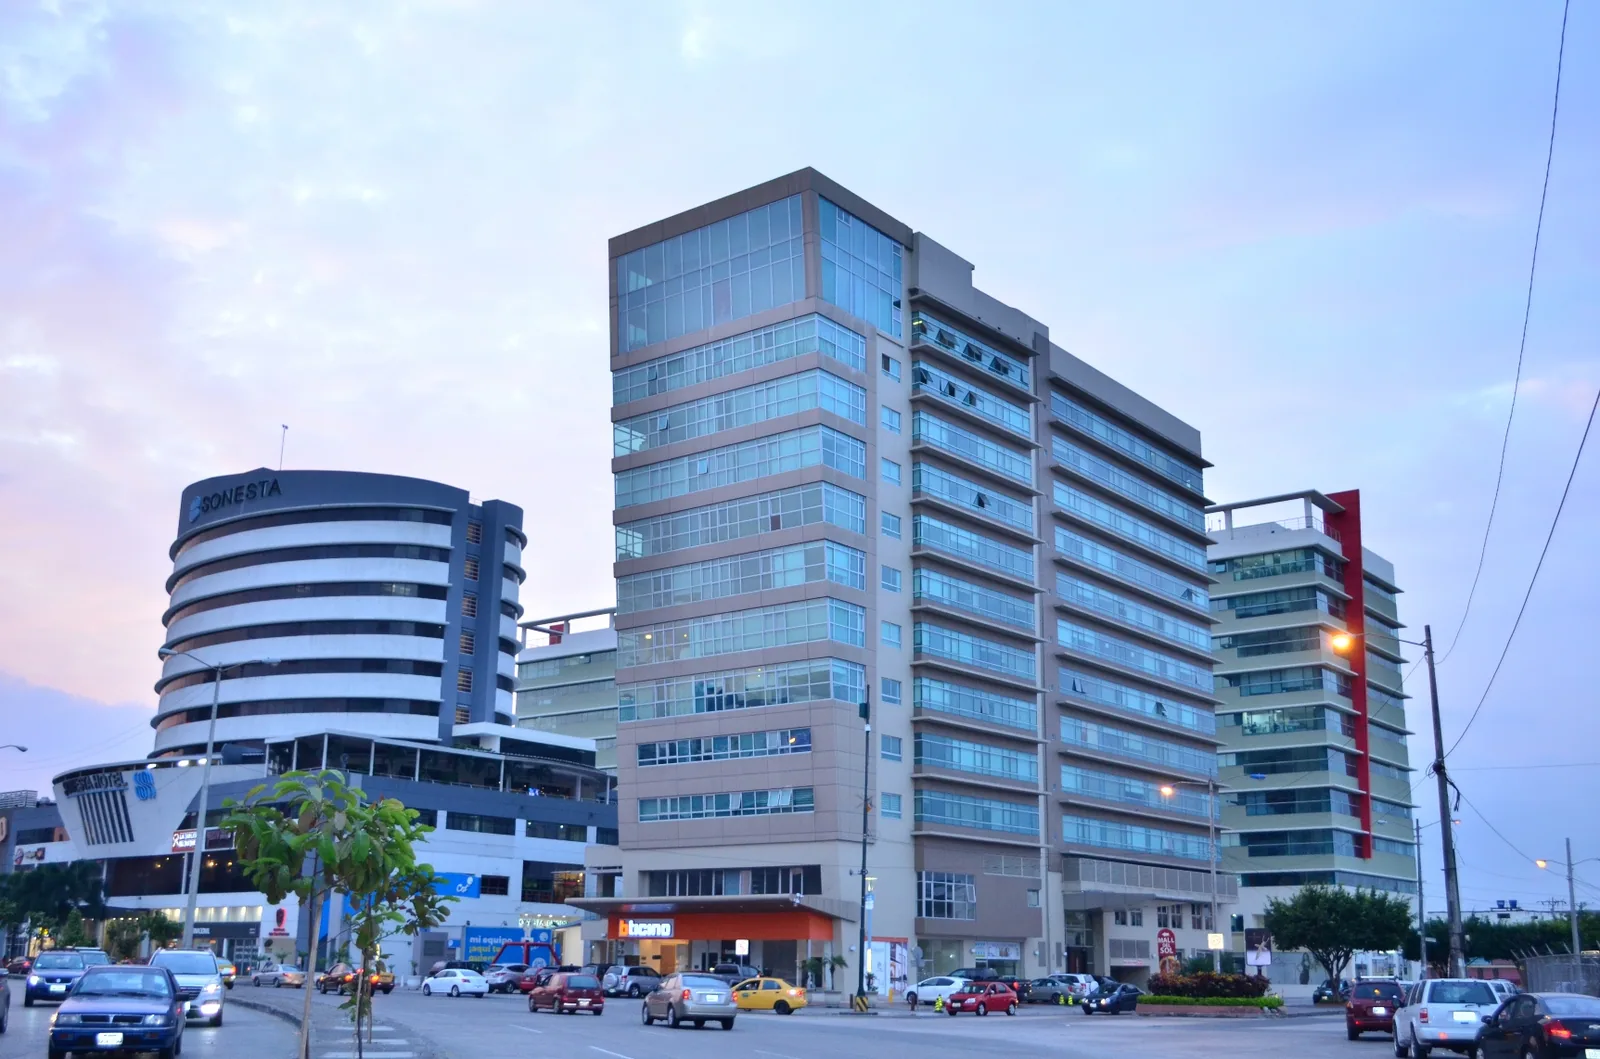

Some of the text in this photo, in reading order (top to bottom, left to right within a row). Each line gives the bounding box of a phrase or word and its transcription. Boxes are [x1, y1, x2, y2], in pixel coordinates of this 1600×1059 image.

[202, 478, 281, 512] SONESTA
[92, 771, 128, 789] HOTEL
[469, 935, 513, 945] mi equipo
